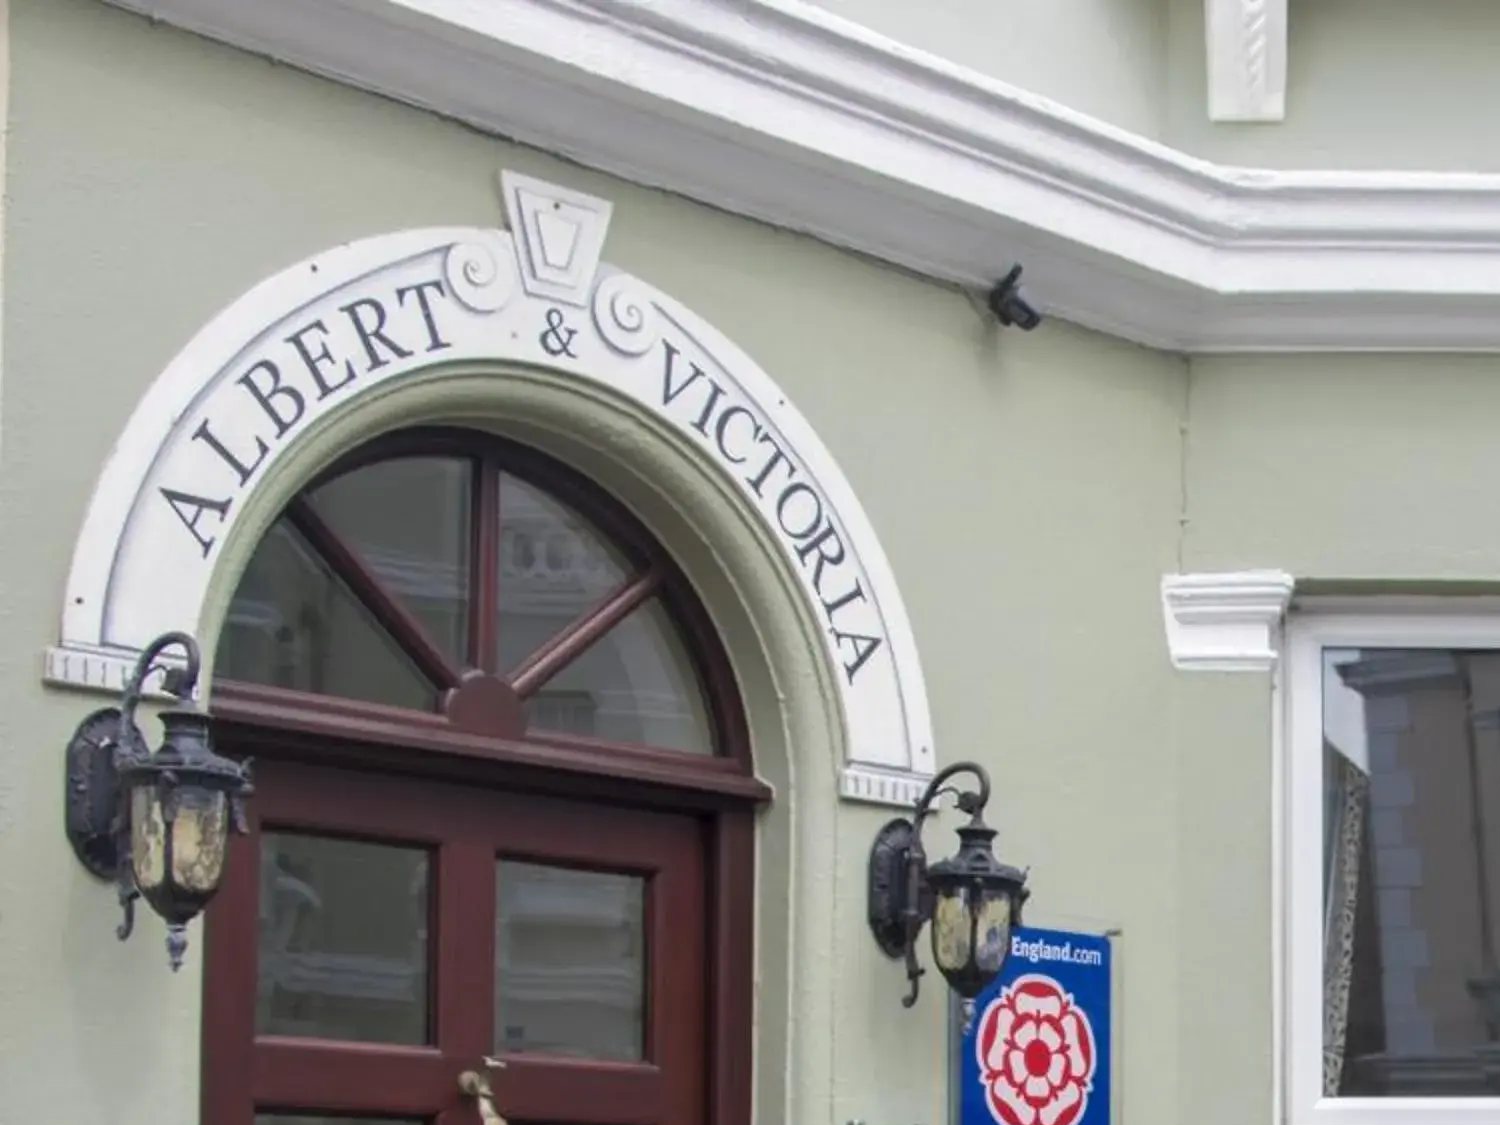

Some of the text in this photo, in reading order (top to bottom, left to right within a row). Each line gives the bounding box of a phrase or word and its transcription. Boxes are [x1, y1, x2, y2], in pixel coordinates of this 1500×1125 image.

[157, 279, 884, 686] ALBERT & VICTORIA
[1011, 936, 1102, 965] England.com
